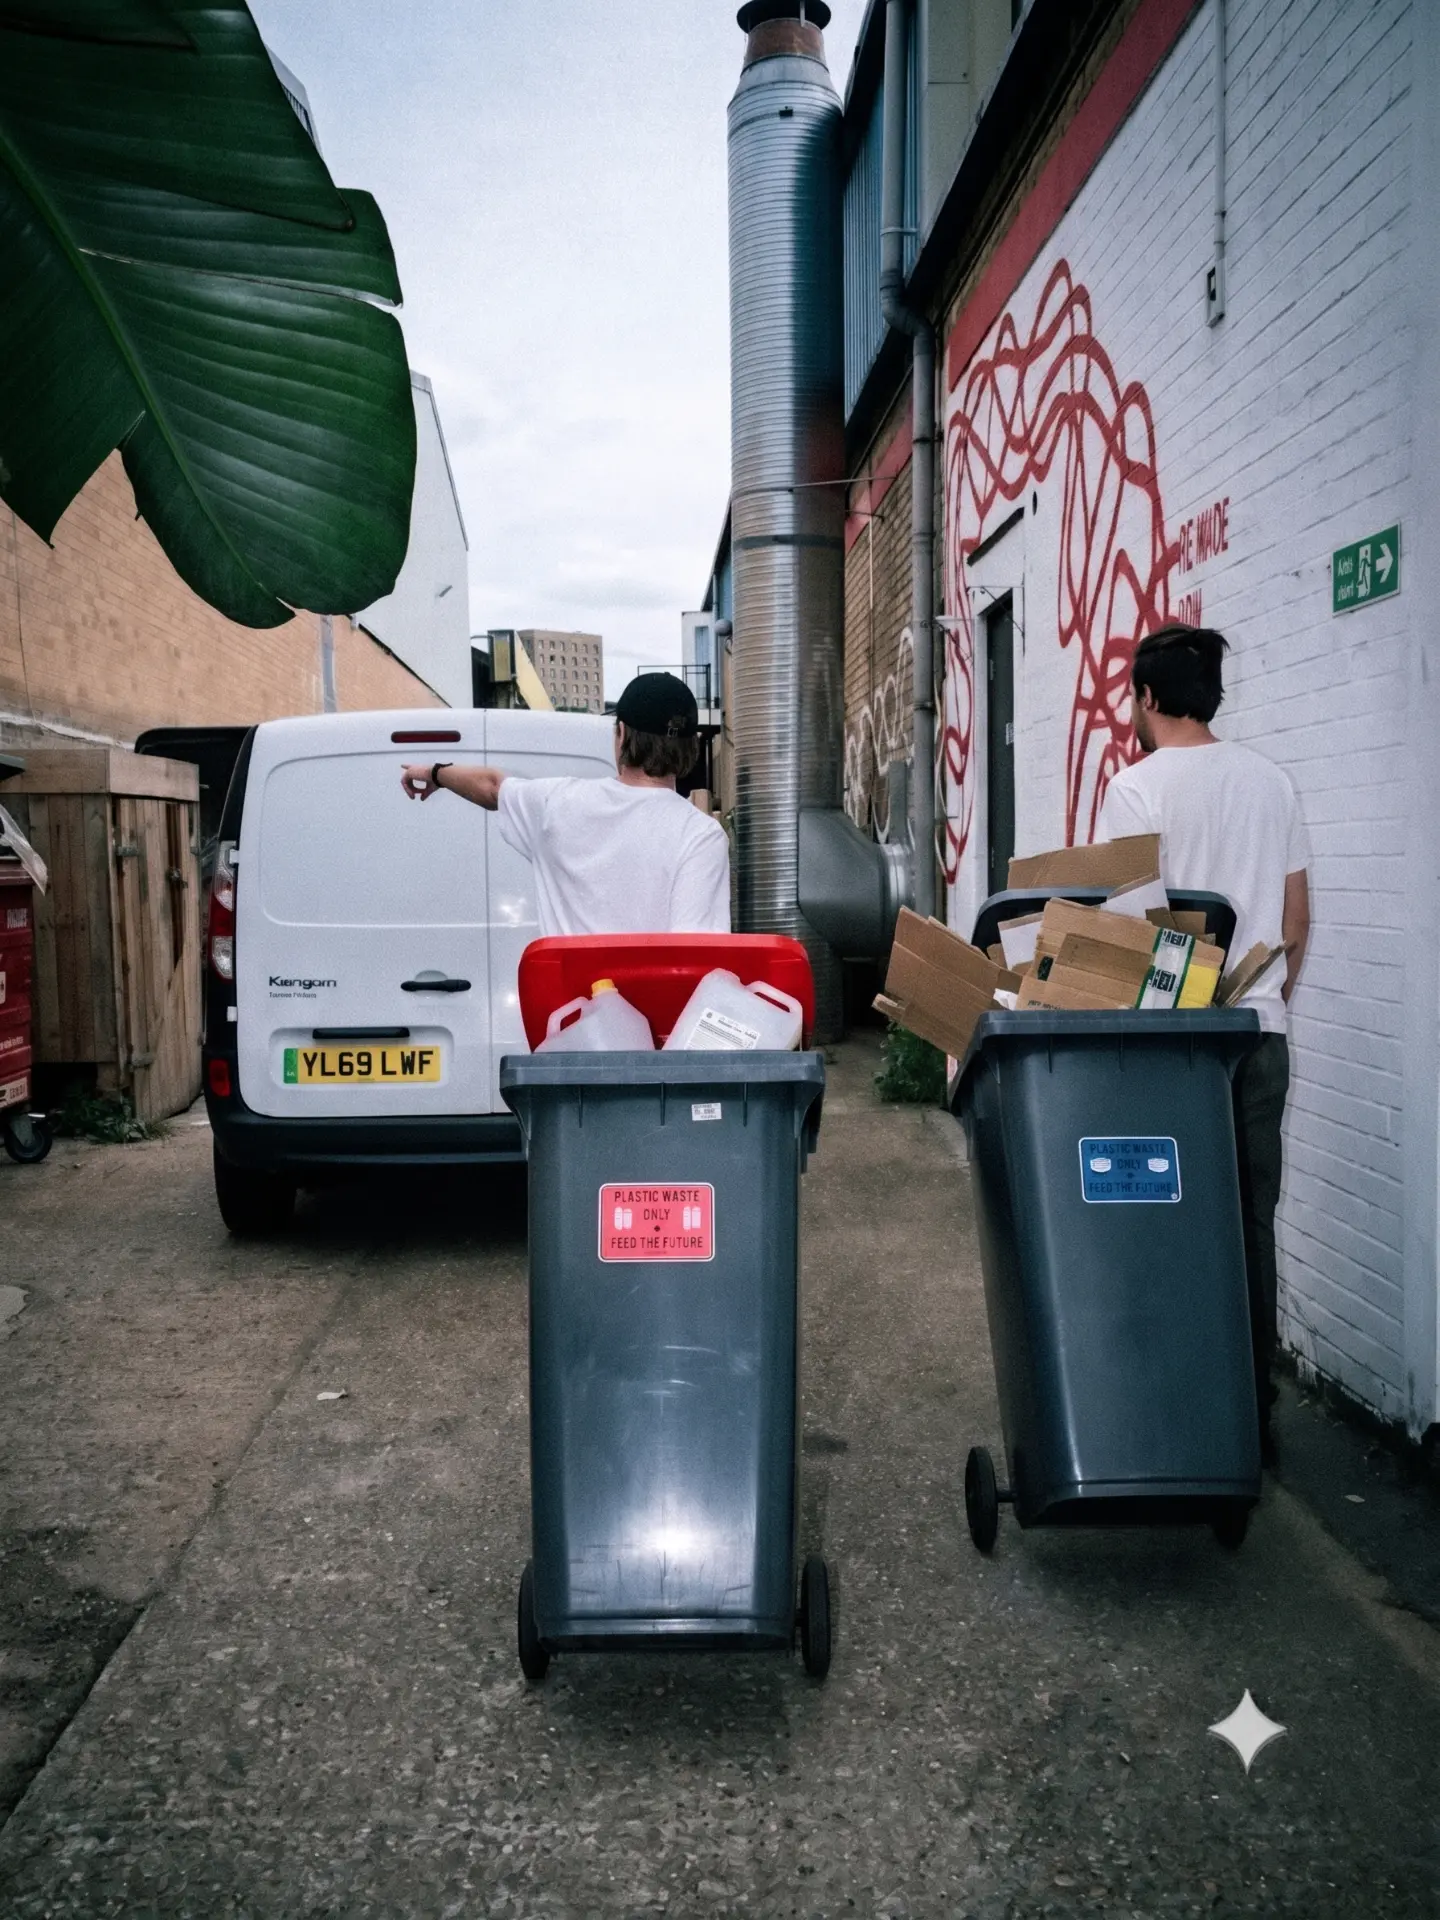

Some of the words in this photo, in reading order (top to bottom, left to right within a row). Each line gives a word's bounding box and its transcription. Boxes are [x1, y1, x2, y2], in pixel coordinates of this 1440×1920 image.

[303, 1051, 373, 1077] YL69
[381, 1050, 434, 1075] LWF
[1089, 1143, 1132, 1154] PLASTIC
[1134, 1143, 1166, 1154] WASTE
[1117, 1158, 1141, 1170] ONLY
[1089, 1182, 1112, 1193] FEED
[1115, 1182, 1133, 1193] THE
[1135, 1182, 1172, 1193] FUTURE
[614, 1190, 659, 1203] PLASTIC
[662, 1190, 700, 1202] WASTE
[643, 1208, 671, 1220] ONLY
[611, 1237, 637, 1249] FEED
[640, 1236, 660, 1249] THE
[662, 1236, 703, 1248] FUTURE
